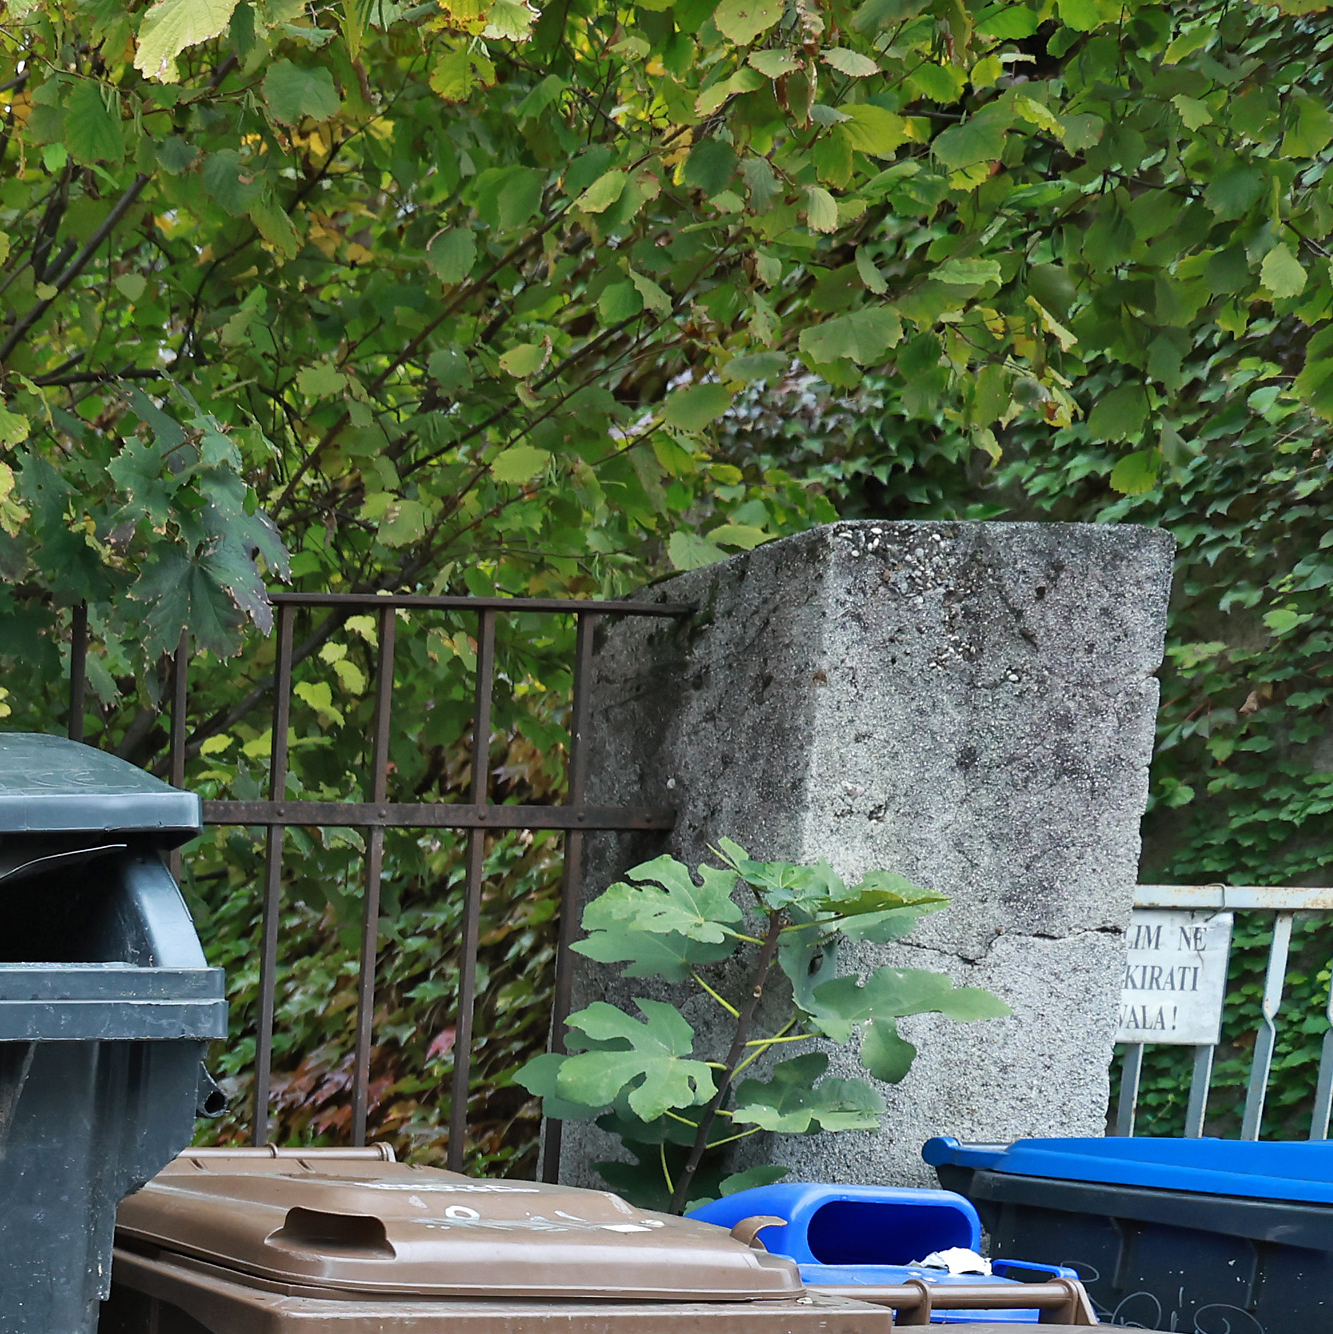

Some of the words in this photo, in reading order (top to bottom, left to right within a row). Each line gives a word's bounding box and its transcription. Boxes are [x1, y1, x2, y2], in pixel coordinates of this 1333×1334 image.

[1129, 925, 1163, 951] IM
[1177, 926, 1207, 952] NE
[1122, 965, 1200, 991] KIRATI
